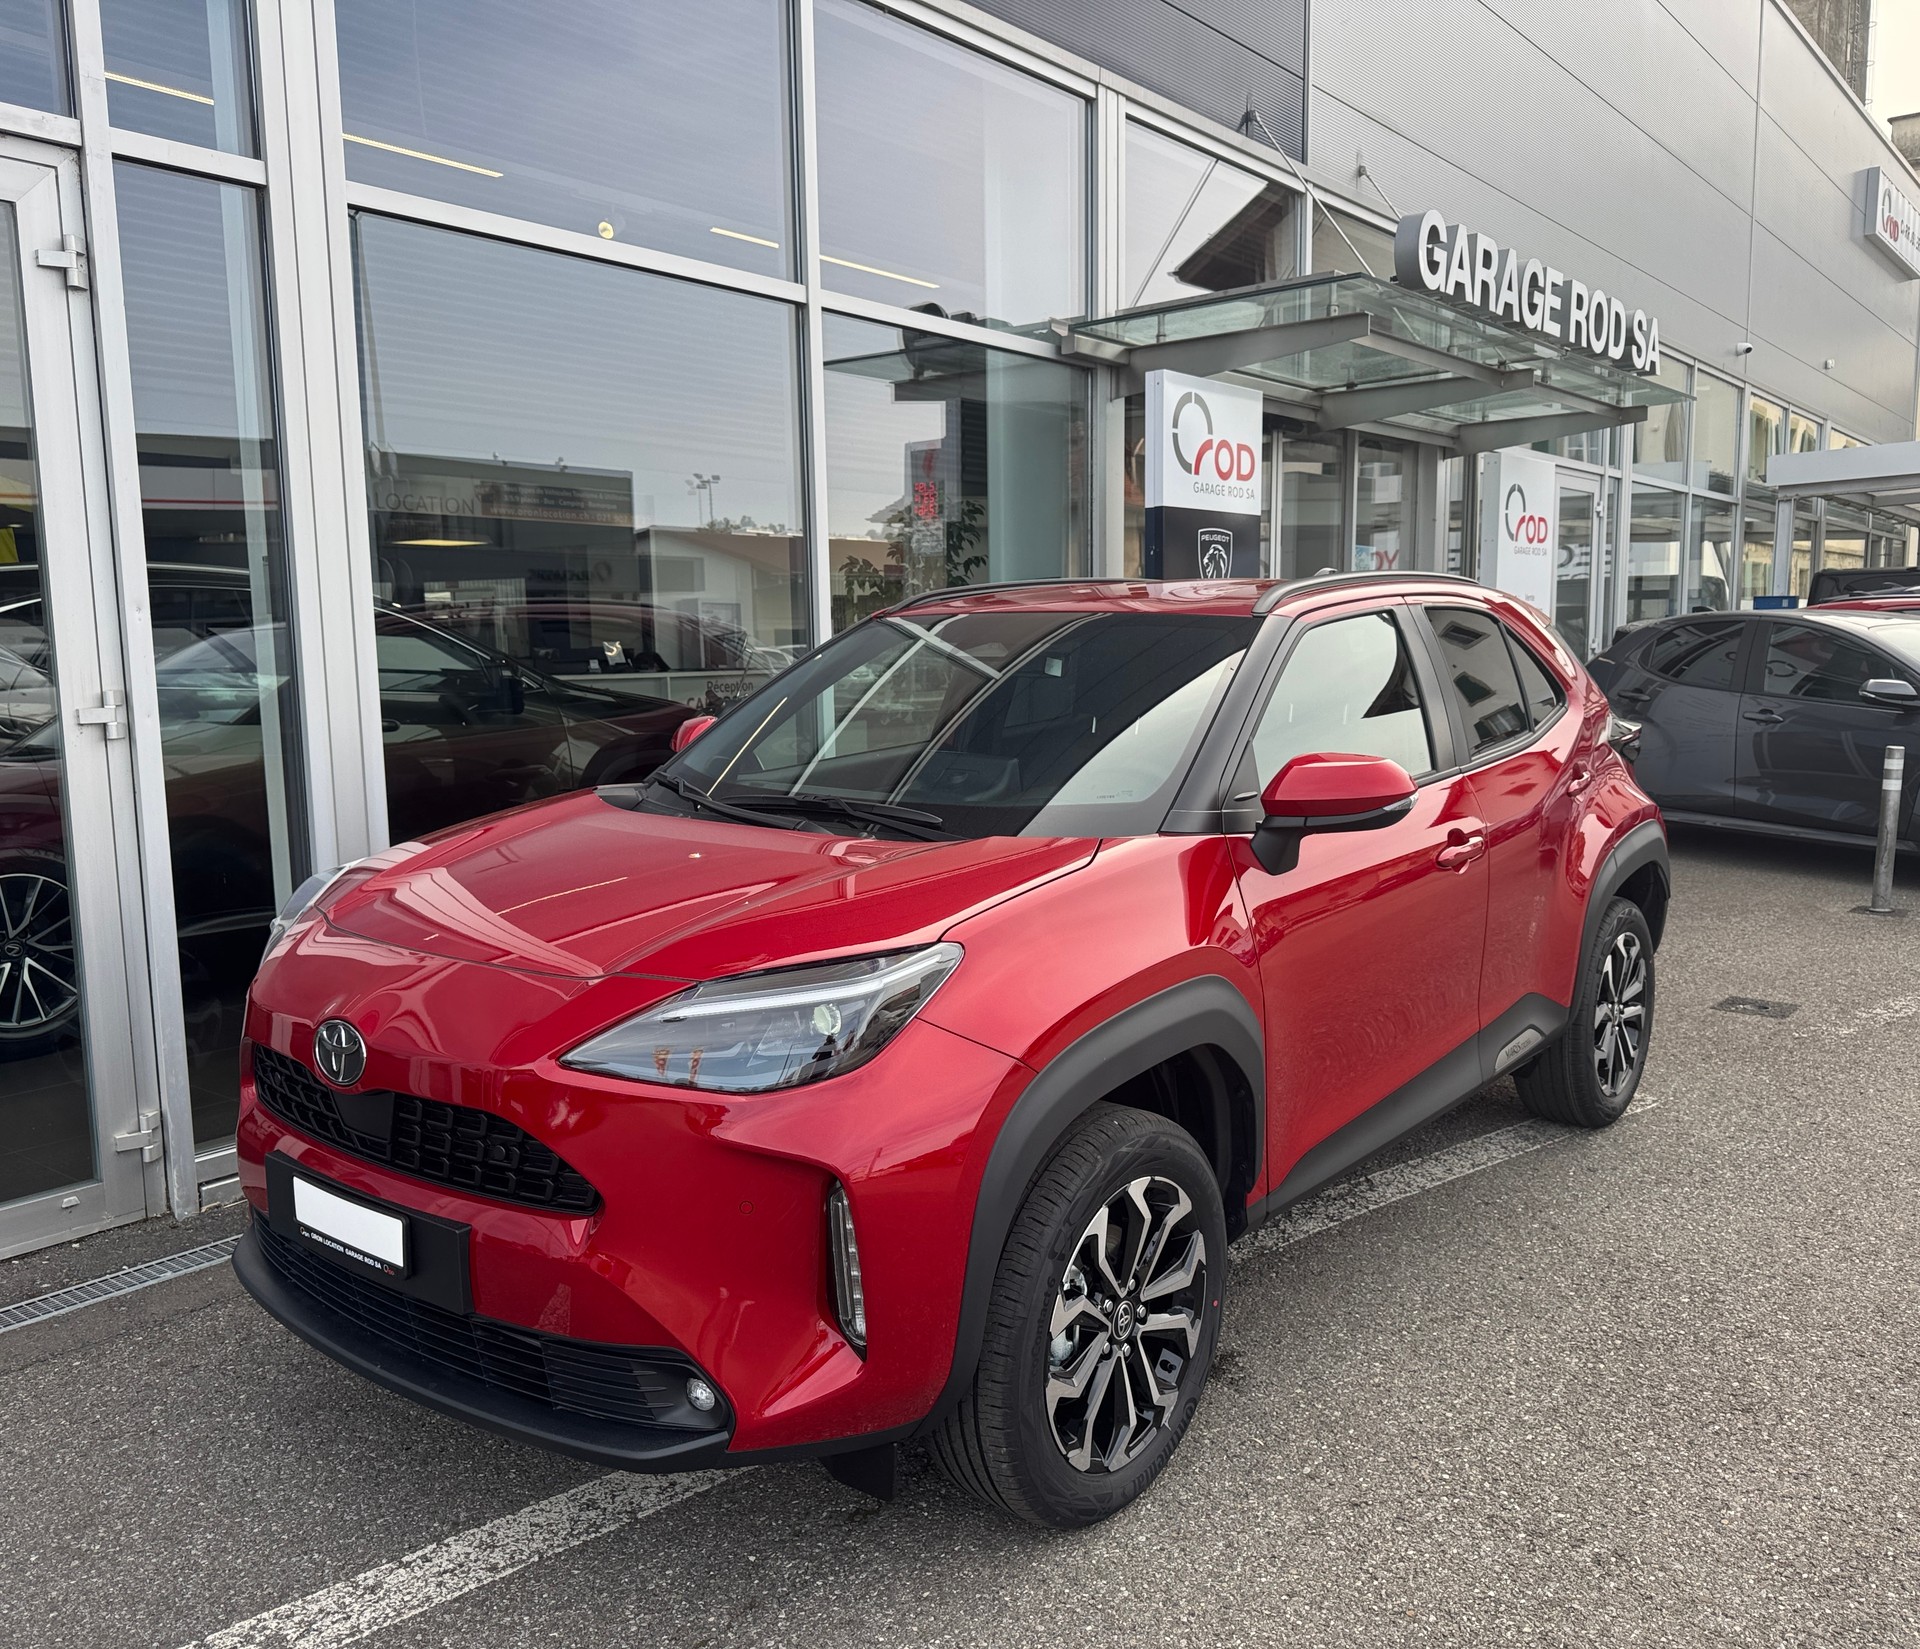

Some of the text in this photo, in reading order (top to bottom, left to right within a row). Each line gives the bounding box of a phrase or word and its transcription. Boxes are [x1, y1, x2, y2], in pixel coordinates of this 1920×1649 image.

[1417, 209, 1661, 376] GARAGE ROD SA
[1193, 481, 1255, 500] GARAGE ROD SA
[375, 491, 476, 515] LOCATION
[1200, 533, 1230, 543] PEUGEOT
[1513, 545, 1531, 556] GARAGE
[1531, 546, 1541, 556] ROD
[323, 1238, 345, 1253] LOCATION
[345, 1248, 364, 1262] GARAGE
[364, 1256, 375, 1267] ROD
